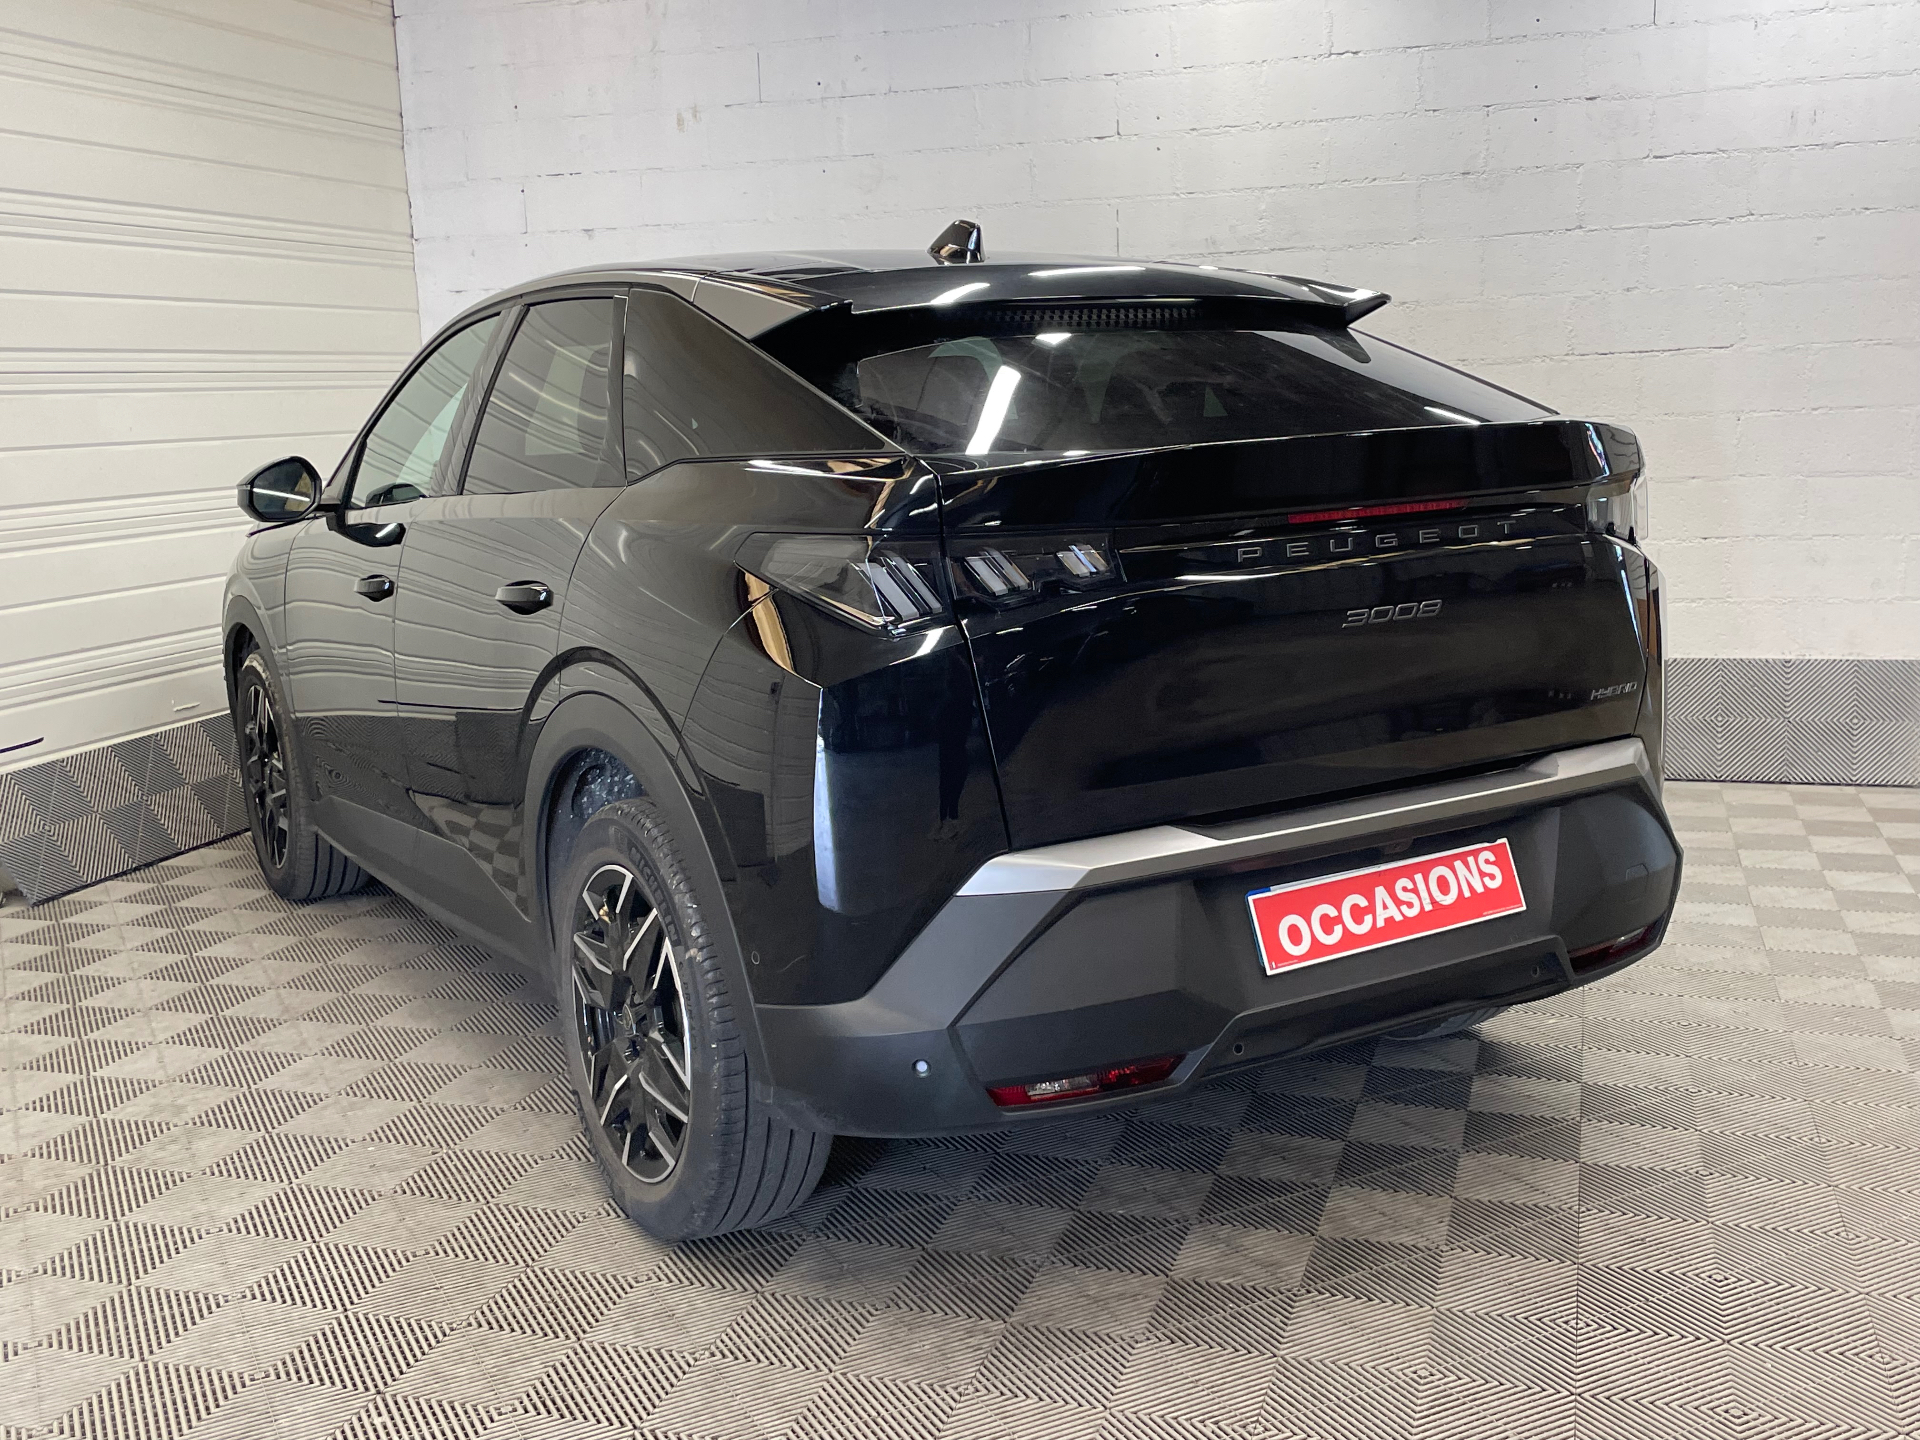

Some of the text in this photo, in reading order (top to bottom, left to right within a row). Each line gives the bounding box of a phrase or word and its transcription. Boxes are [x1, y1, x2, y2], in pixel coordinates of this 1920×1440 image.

[1237, 519, 1516, 563] PEUGEOT
[1341, 599, 1443, 629] 3008
[1590, 681, 1638, 701] HYBRID
[629, 845, 679, 944] MICHELIN
[1278, 850, 1503, 957] OCCASIONS
